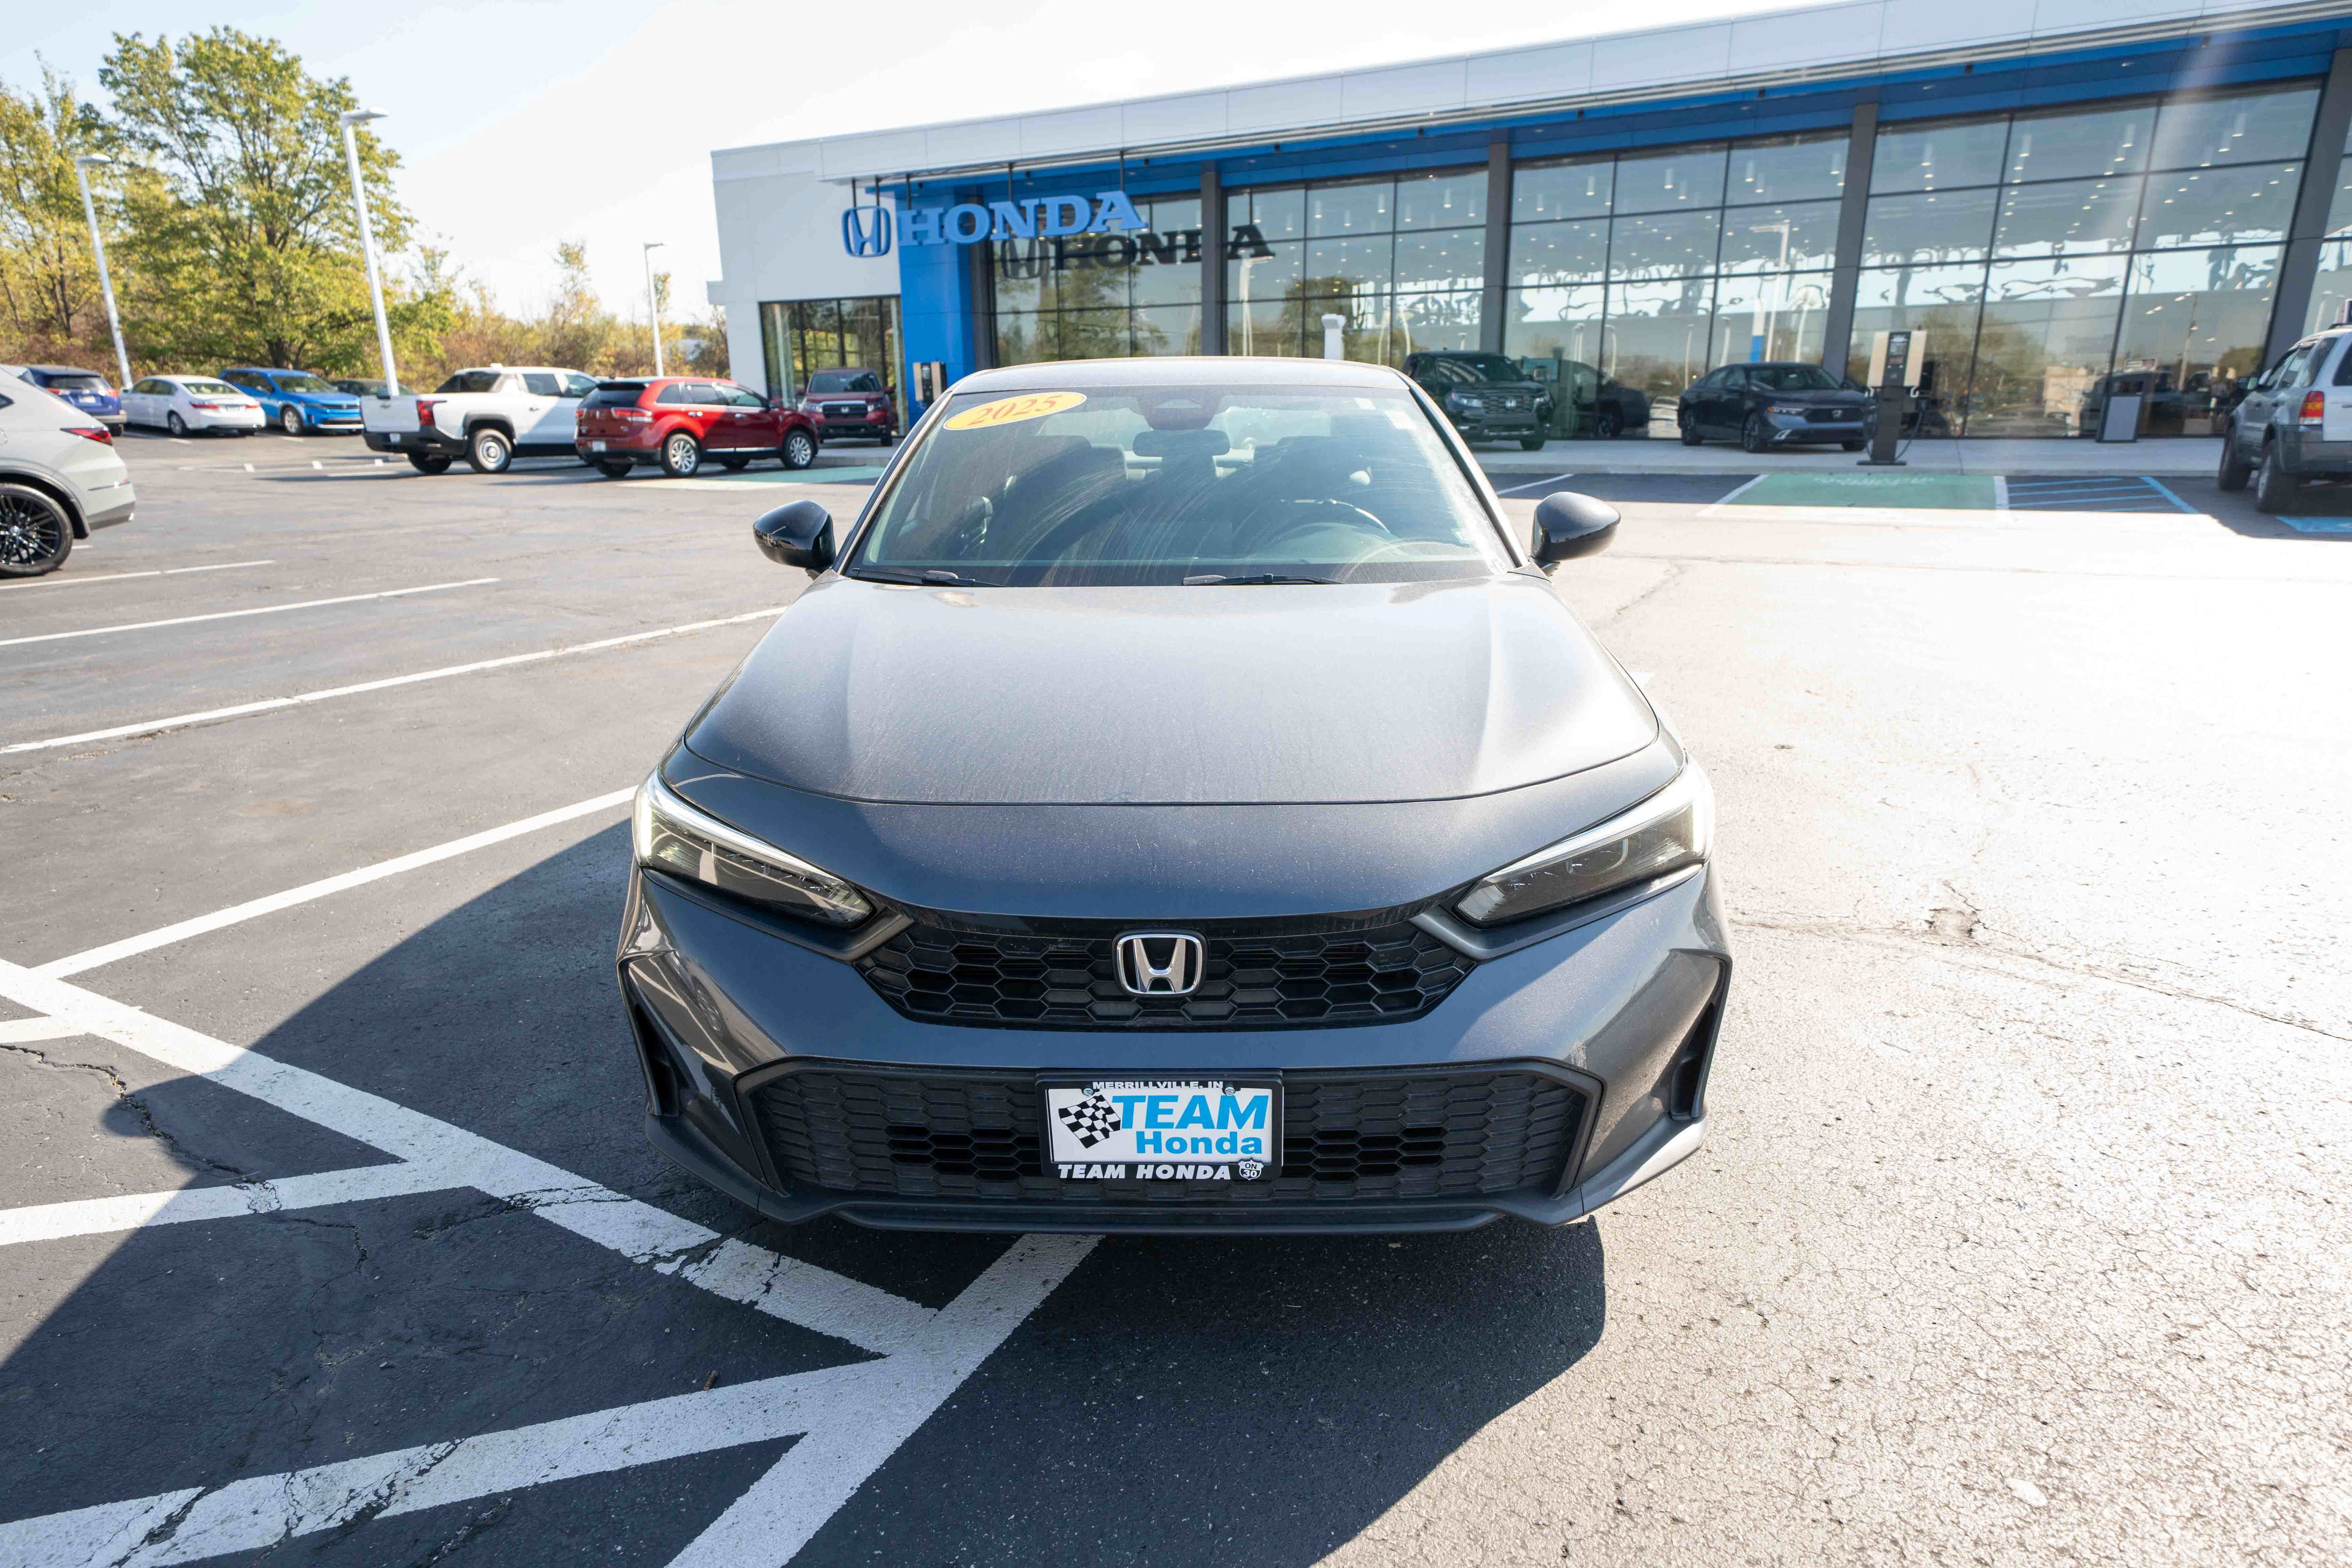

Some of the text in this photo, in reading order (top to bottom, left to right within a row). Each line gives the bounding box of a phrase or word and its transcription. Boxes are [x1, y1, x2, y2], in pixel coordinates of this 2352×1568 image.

[899, 190, 1148, 245] HONDA
[967, 395, 1062, 425] 2025
[1092, 1081, 1203, 1089] MERRILLVILLE,
[1112, 1095, 1269, 1129] TEAM
[1136, 1131, 1263, 1154] Honda
[1058, 1164, 1231, 1180] TEAM HONDA
